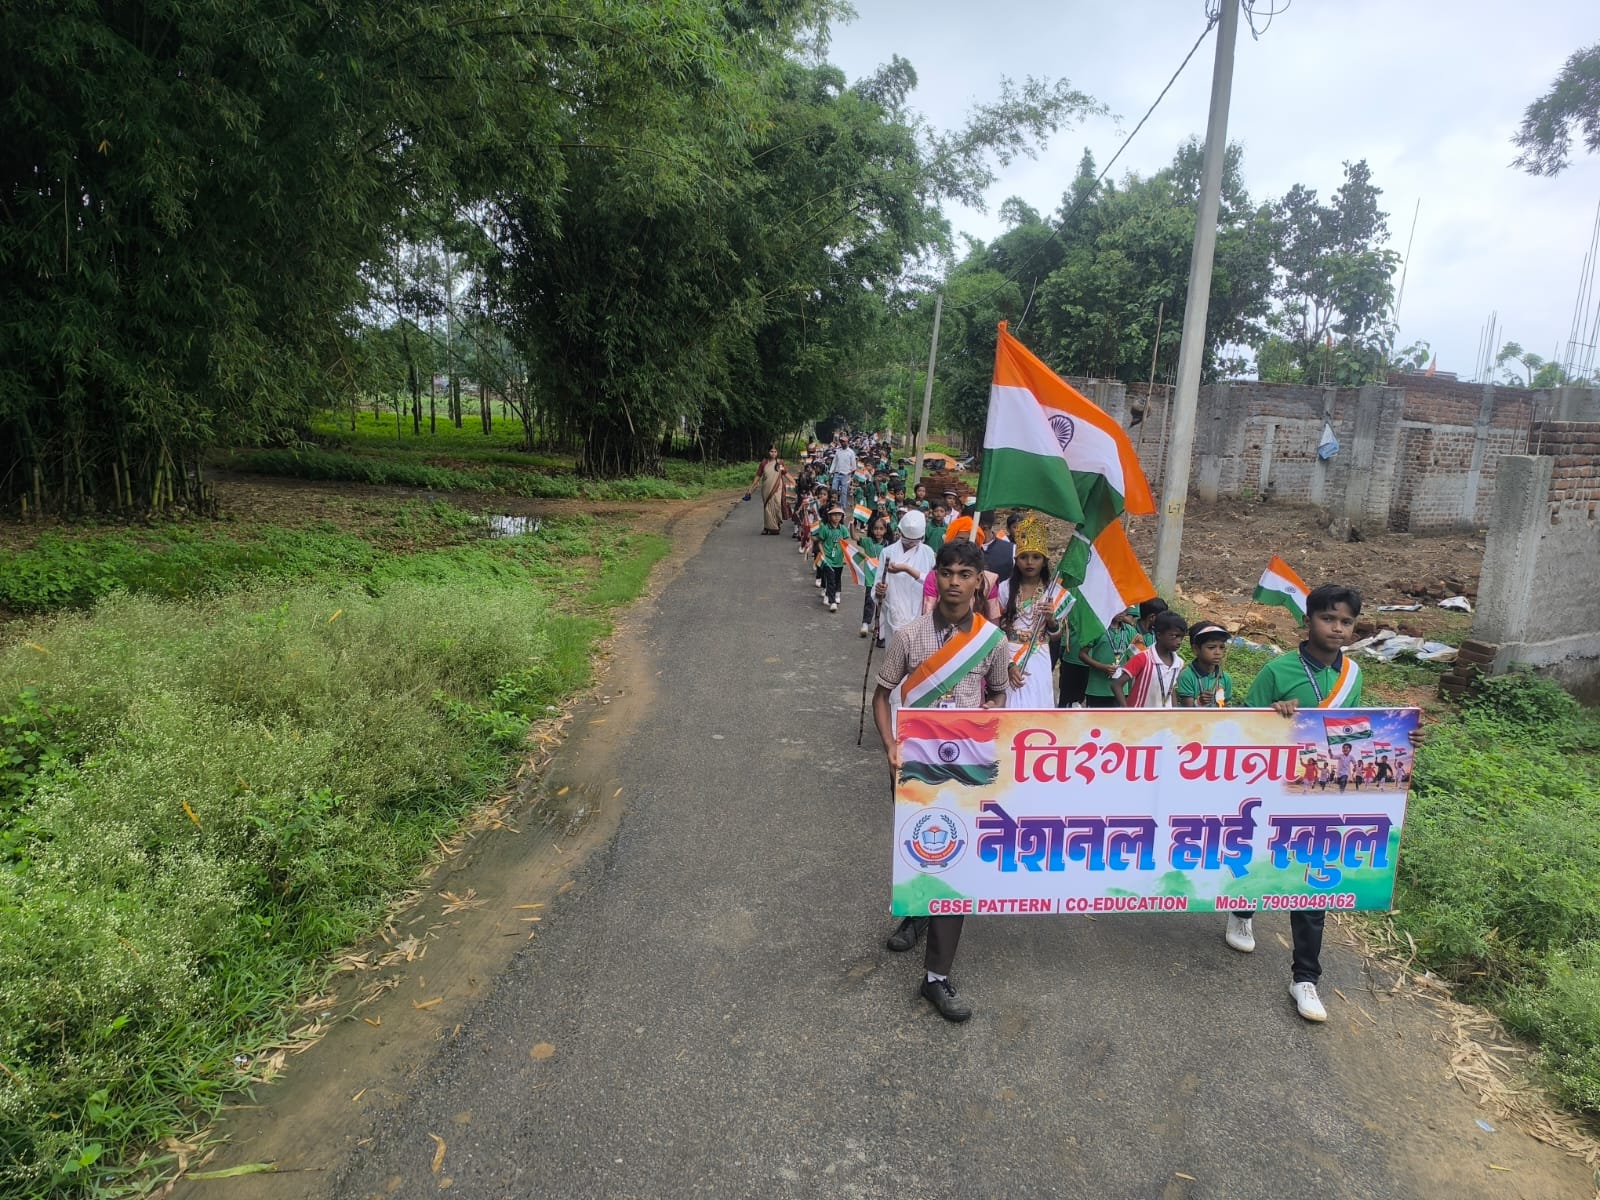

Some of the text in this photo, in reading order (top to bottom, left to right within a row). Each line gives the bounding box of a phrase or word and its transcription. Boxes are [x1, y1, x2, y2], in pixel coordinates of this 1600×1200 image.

[1011, 729, 1305, 784] तिरंगा यात्रा
[976, 798, 1393, 889] नेशनल हाई स्कुल
[928, 899, 973, 913] CBSE
[978, 898, 1051, 912] PATTERN
[1065, 896, 1188, 911] CO-EDUCATION
[1215, 893, 1355, 910] Mob.: 7903048162
